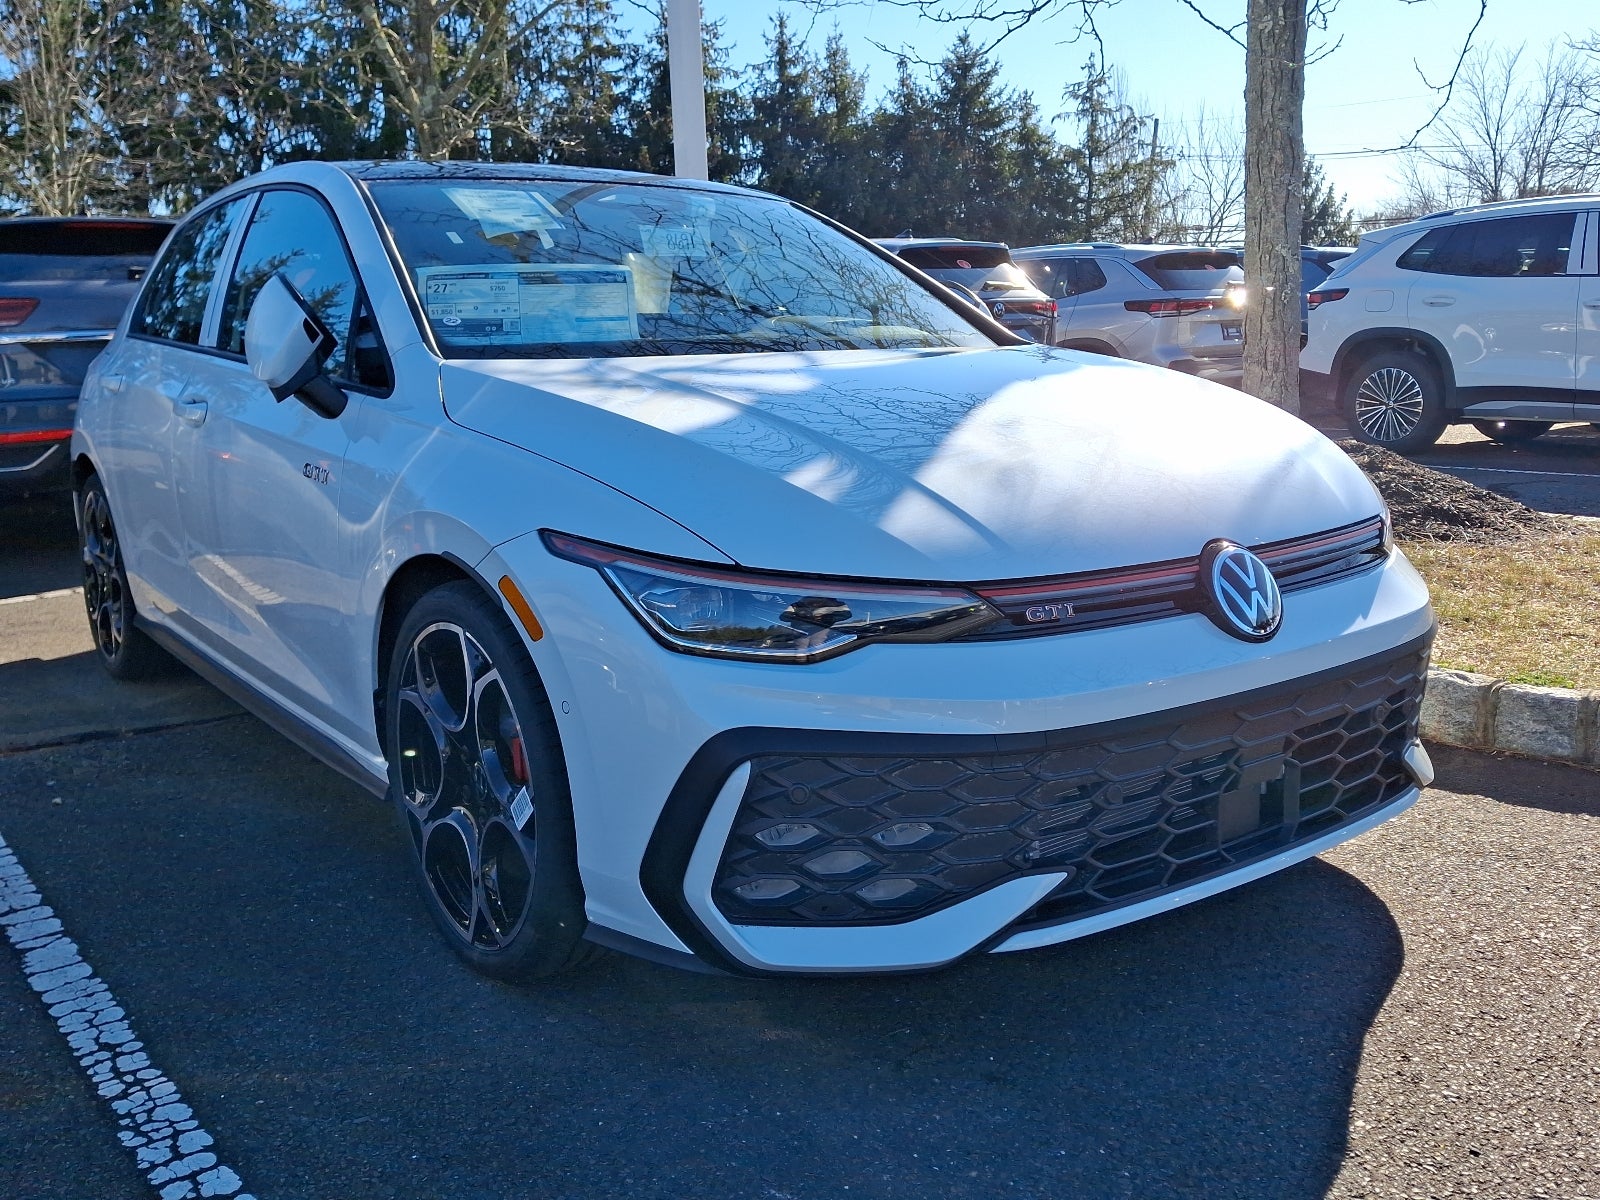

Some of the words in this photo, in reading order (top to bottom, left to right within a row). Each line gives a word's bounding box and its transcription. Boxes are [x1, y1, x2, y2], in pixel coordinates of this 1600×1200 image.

[433, 283, 448, 294] 27
[303, 462, 330, 485] GTI
[1025, 602, 1076, 623] GTI
